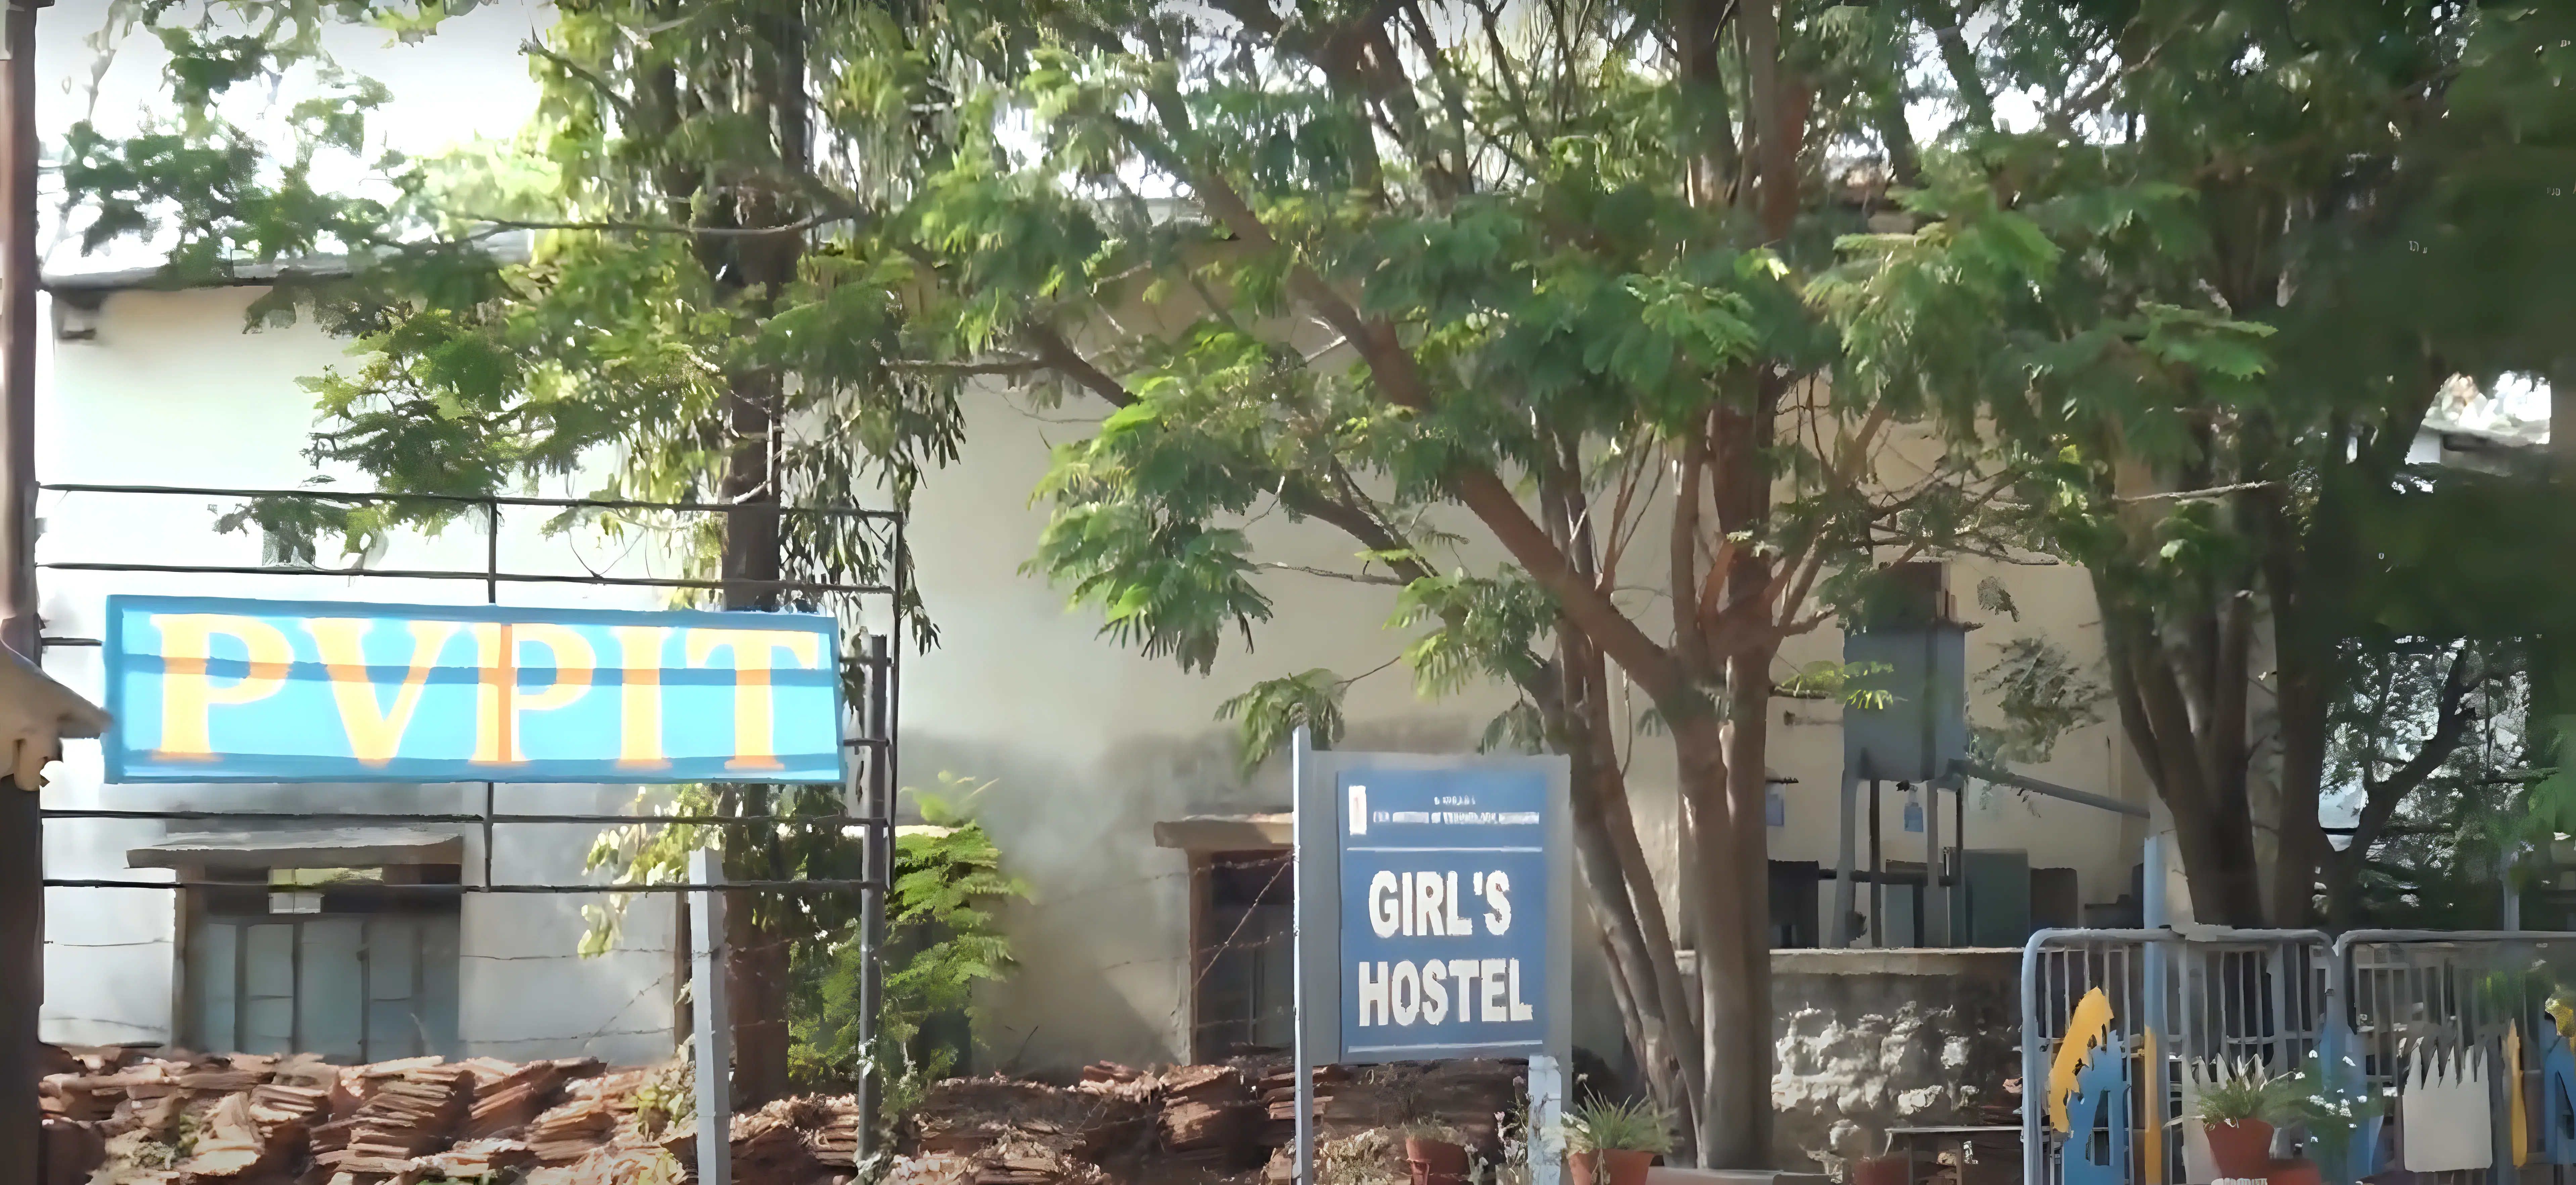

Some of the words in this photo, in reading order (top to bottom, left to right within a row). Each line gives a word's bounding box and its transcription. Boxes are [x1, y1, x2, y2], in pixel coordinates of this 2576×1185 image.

[150, 613, 818, 770] PVPIT
[1368, 870, 1512, 938] GIRL'S
[1359, 958, 1533, 1026] HOSTEL
